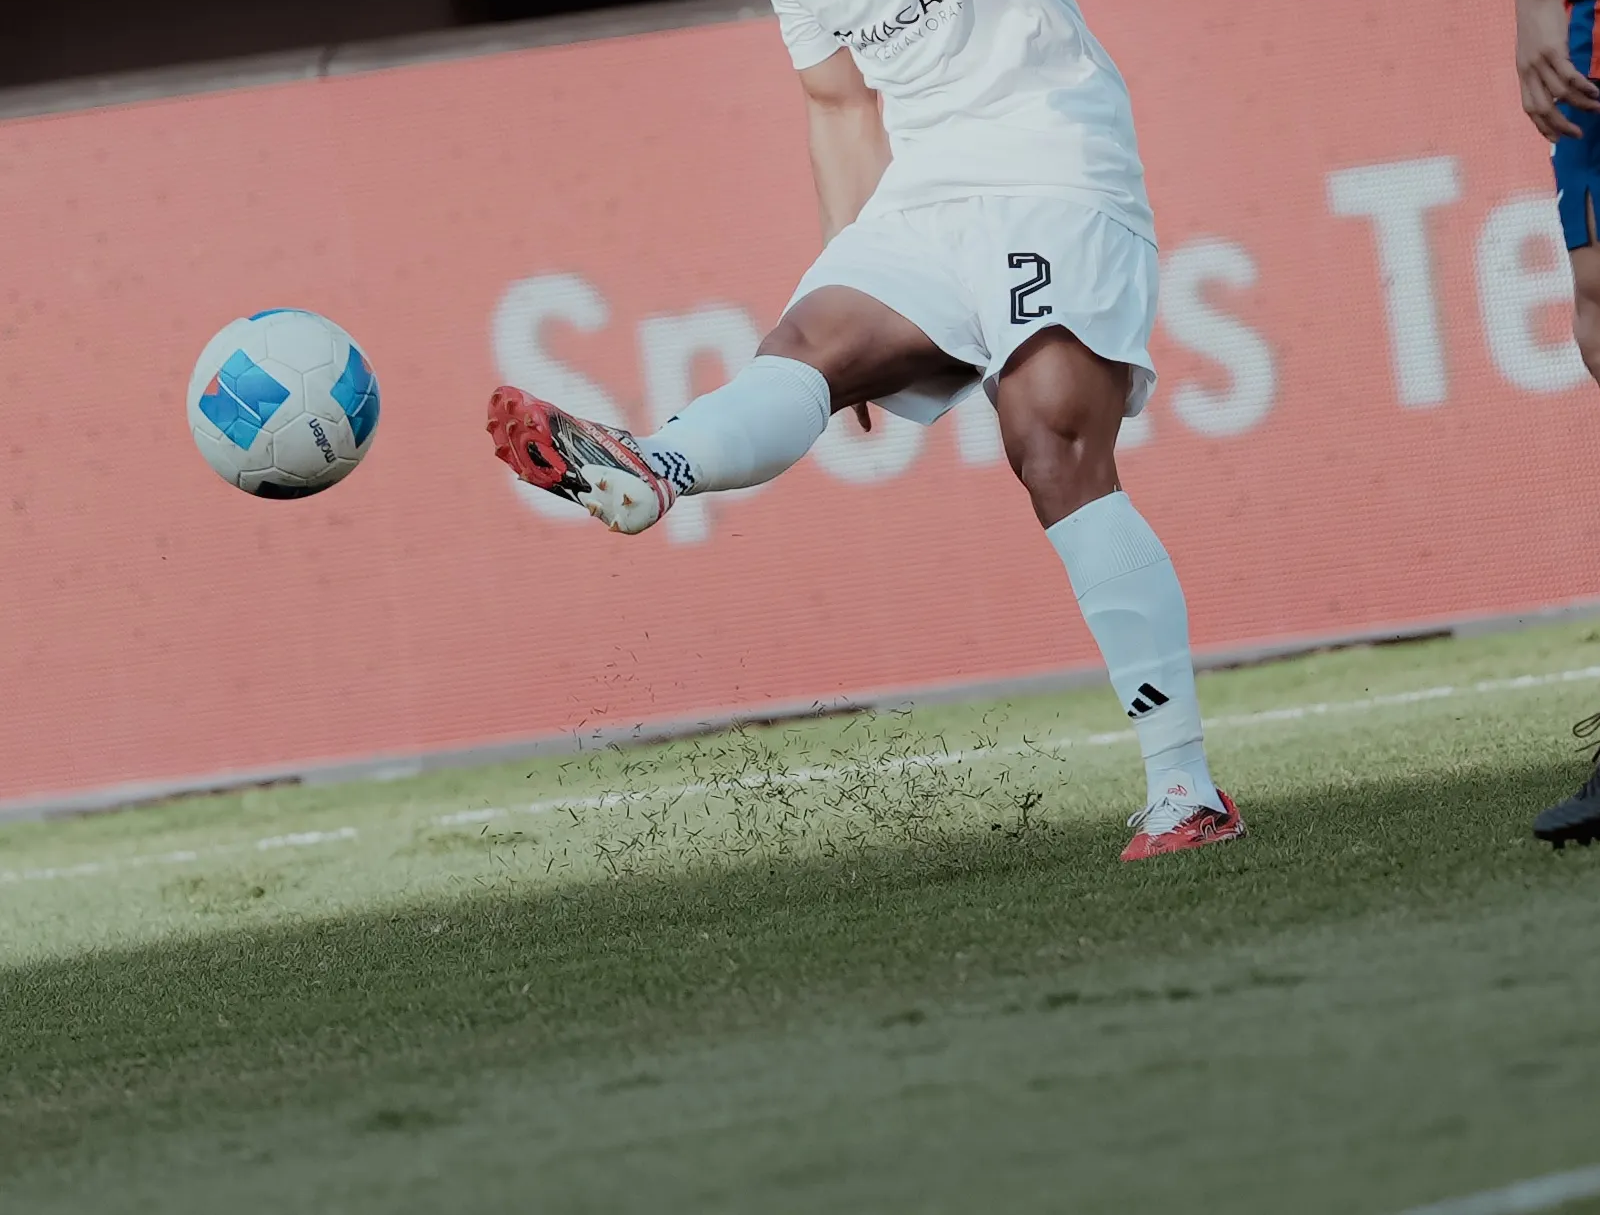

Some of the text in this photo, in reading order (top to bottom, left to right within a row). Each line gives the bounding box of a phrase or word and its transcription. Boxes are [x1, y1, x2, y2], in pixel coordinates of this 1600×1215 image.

[1008, 252, 1052, 324] 2
[490, 237, 1278, 544] Sps
[308, 418, 337, 464] molten
